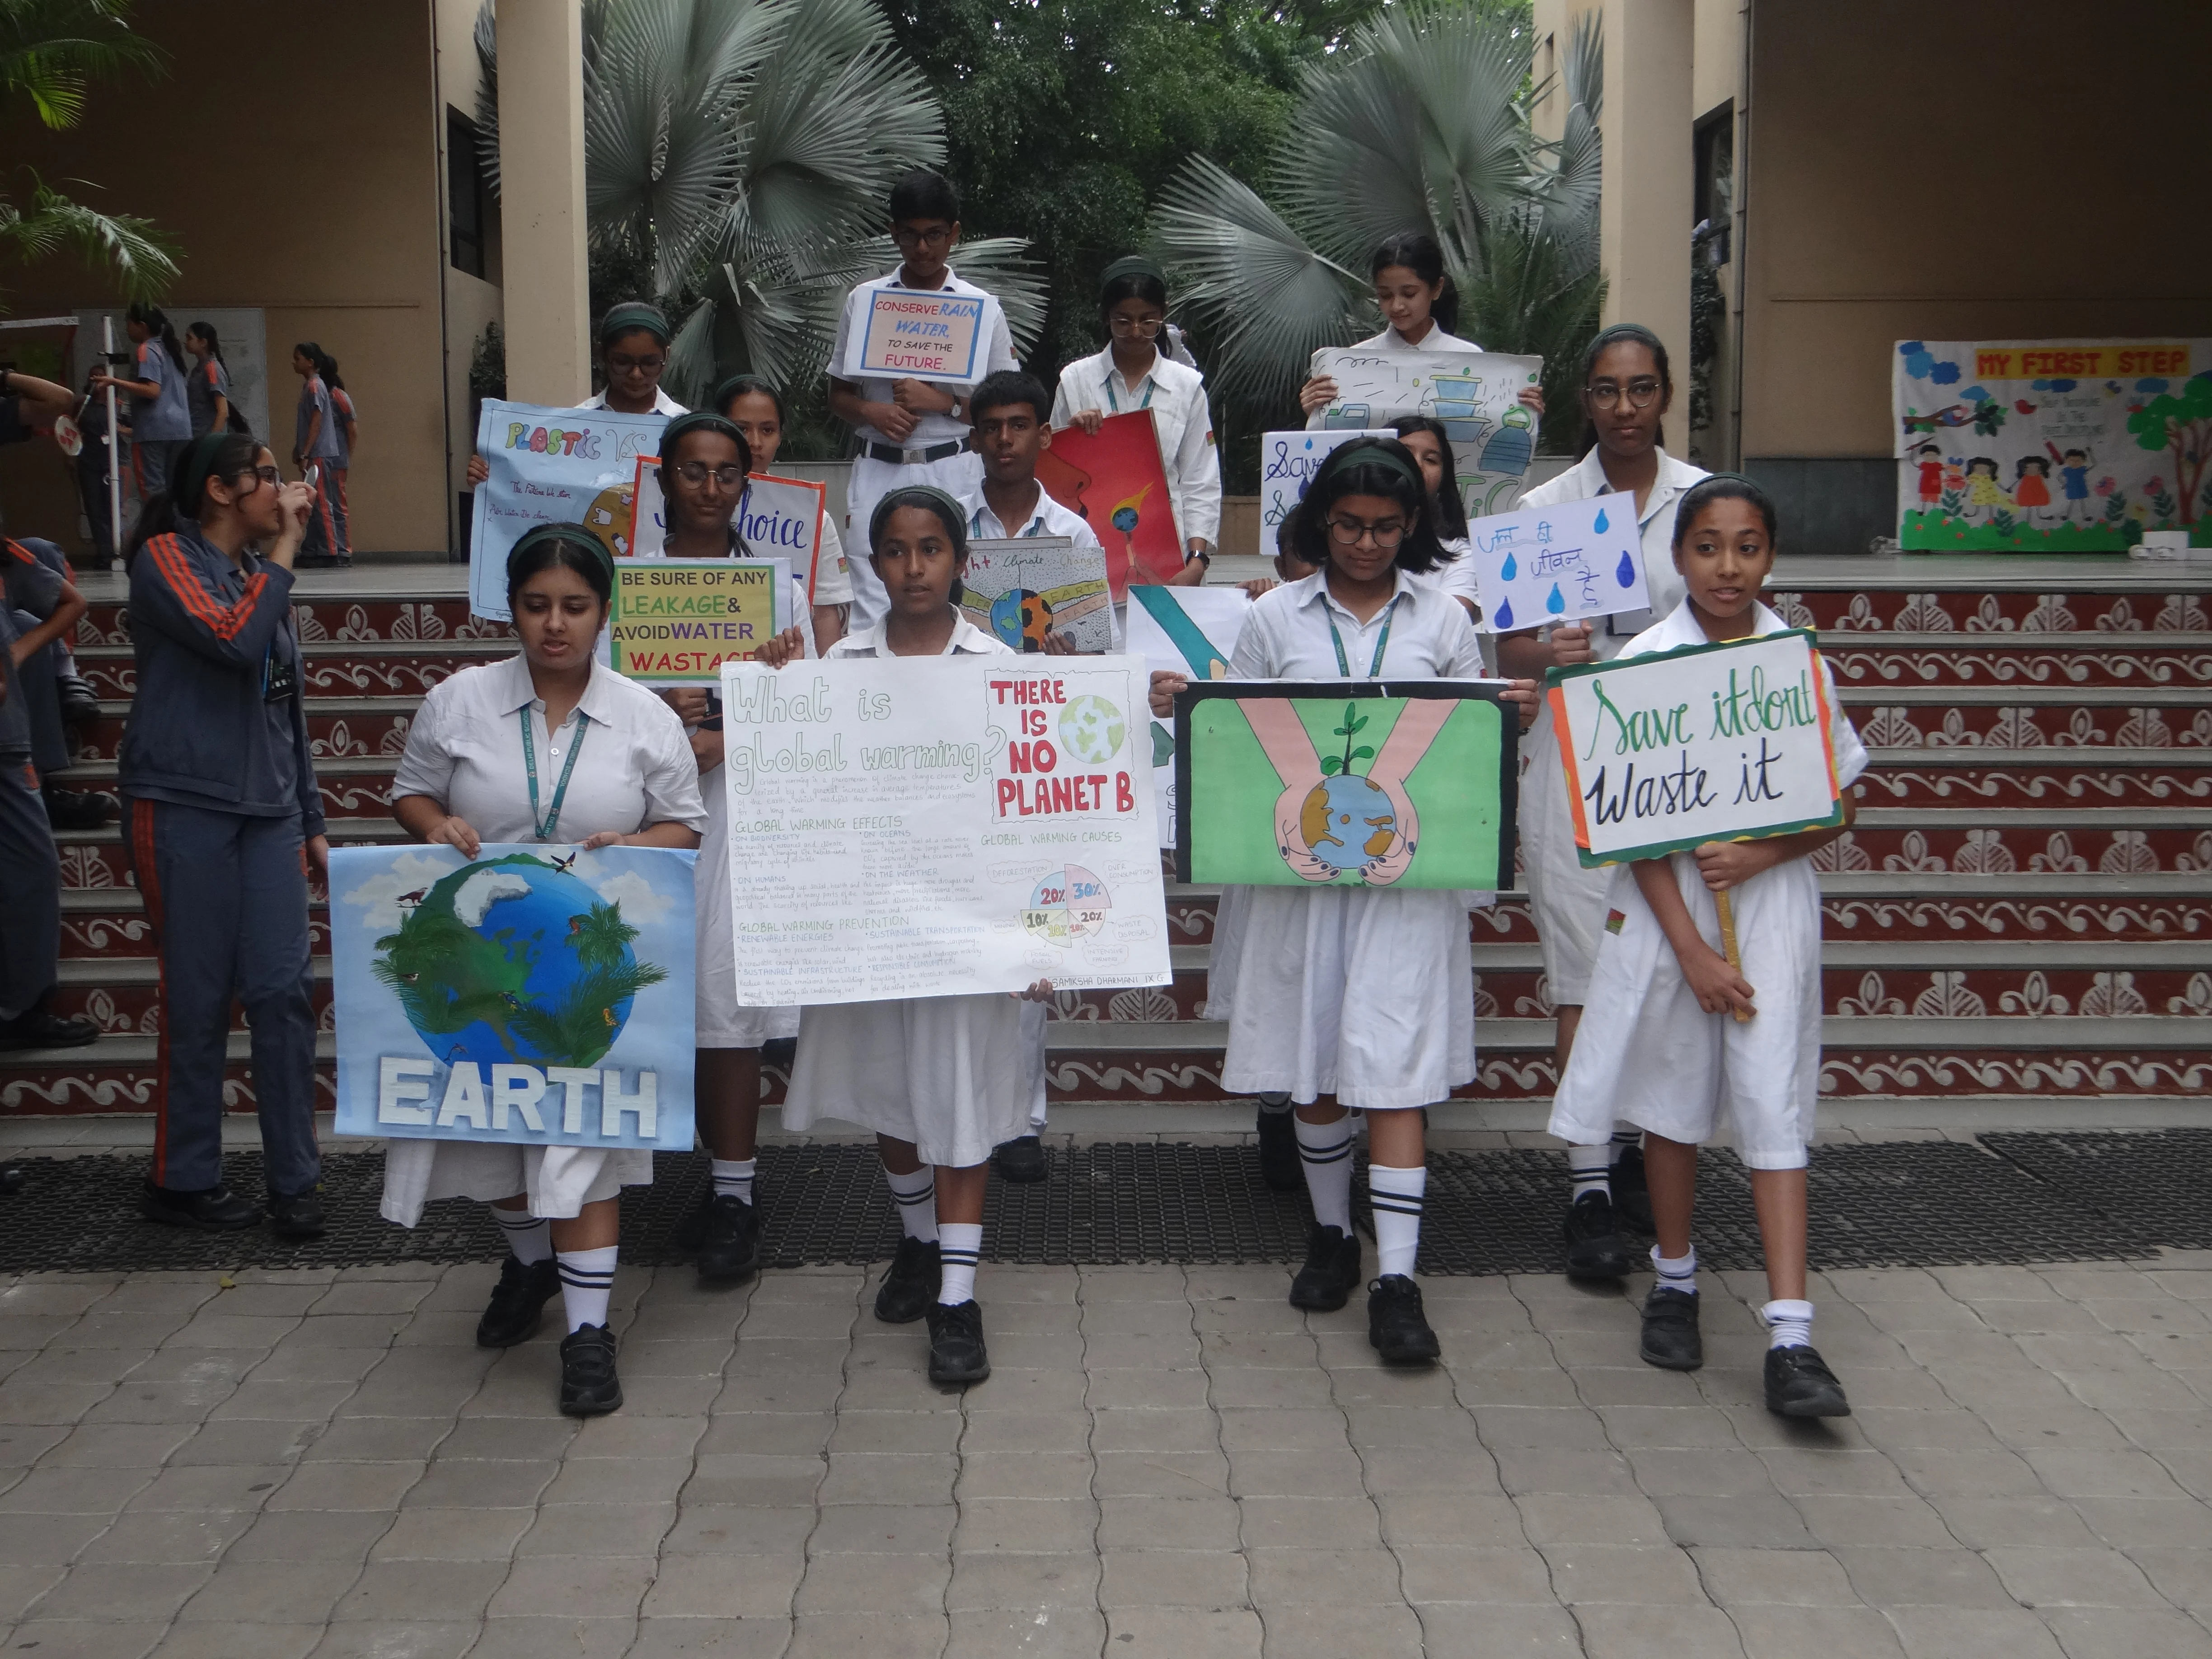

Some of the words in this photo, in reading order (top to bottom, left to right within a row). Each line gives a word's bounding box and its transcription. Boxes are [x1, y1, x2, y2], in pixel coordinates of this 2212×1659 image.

[875, 301, 939, 315] CONSERVE
[938, 302, 979, 319] RAIN
[888, 339, 901, 347] TO
[904, 341, 932, 351] SAVE
[933, 342, 953, 352] THE
[884, 354, 947, 370] FUTURE.
[1978, 354, 2011, 375] MY
[2022, 352, 2101, 375] FIRST
[2118, 351, 2186, 373] STEP
[511, 481, 522, 493] The
[736, 484, 807, 548] hoice
[1003, 555, 1044, 567] Climate
[1060, 552, 1100, 570] Change
[622, 572, 645, 586] BE
[651, 572, 697, 586] SURE
[703, 572, 726, 585] OF
[731, 572, 767, 585] ANY
[1050, 582, 1105, 602] EARTH
[623, 595, 726, 615] LEAKAGE
[1064, 597, 1107, 620] EARTH
[612, 625, 670, 641] AVOID
[670, 623, 754, 640] WATER
[731, 675, 832, 724] What
[858, 689, 892, 722] is
[990, 680, 1067, 704] THERE
[1021, 709, 1047, 736] IS
[1583, 679, 1693, 761] Save
[730, 731, 848, 795] global
[1009, 740, 1057, 773] NO
[785, 777, 809, 787] warming
[884, 774, 907, 782] climate
[912, 773, 935, 784] change
[1585, 750, 1718, 825] Waste
[1733, 737, 1783, 806] it
[786, 787, 795, 799] by
[997, 774, 1107, 817] PLANET
[1116, 771, 1134, 812] B
[544, 816, 555, 834] DELHI
[735, 819, 785, 834] GLOBAL
[790, 818, 846, 831] WARMING
[853, 815, 903, 830] EFFECTS
[981, 834, 1024, 846] GLOBAL
[1030, 832, 1077, 844] WARMING
[1082, 832, 1122, 842] CAUSES
[897, 868, 939, 877] WEATHER
[993, 866, 1048, 877] DEFORESTATION
[1109, 869, 1153, 878] CONSUMPTION
[1040, 888, 1065, 904] 20%
[1073, 883, 1101, 899] 30%
[739, 923, 779, 933] GLOBAL
[783, 920, 834, 931] WARMING
[840, 916, 909, 930] PREVENTION
[1026, 913, 1049, 928] 10%
[1081, 911, 1102, 923] 20%
[741, 934, 787, 943] RENEWABLE
[792, 933, 834, 942] ENERGIES
[869, 928, 921, 939] SUSTAINABLE
[1048, 924, 1067, 937] 10%
[1118, 930, 1149, 938] DISPOSAL
[872, 961, 910, 972] RESPONSIBLE
[1052, 978, 1093, 988] SAMIKSHA
[1097, 976, 1139, 985] DHARMANI
[1145, 974, 1153, 983] IX
[379, 1056, 657, 1138] EARTH
